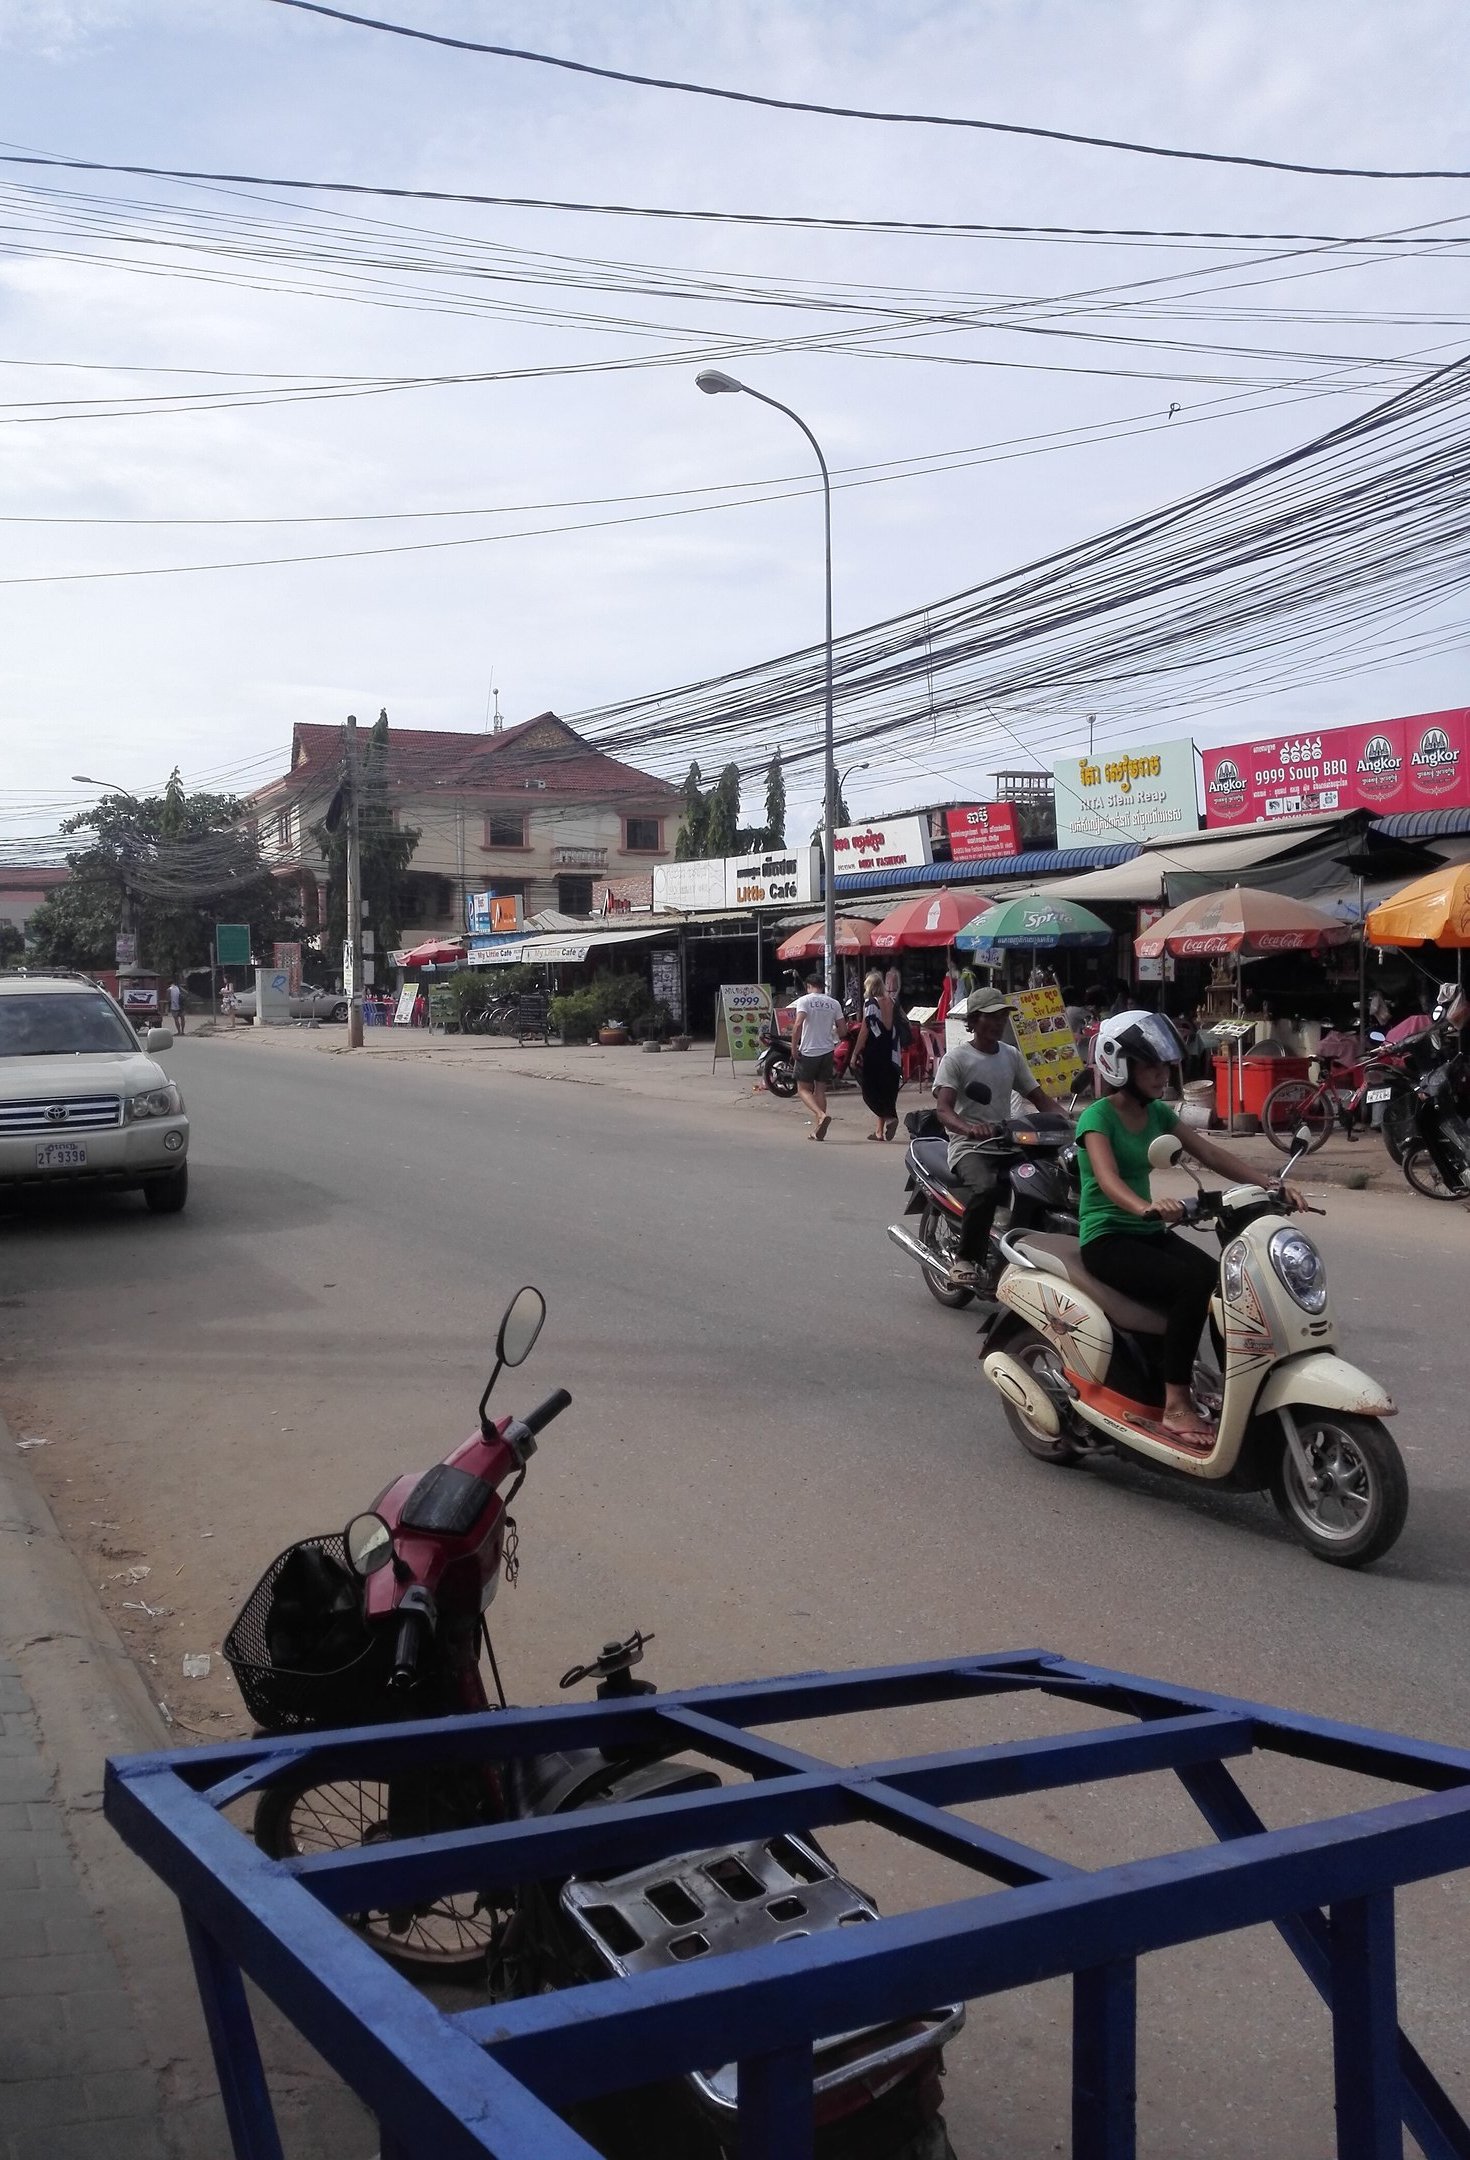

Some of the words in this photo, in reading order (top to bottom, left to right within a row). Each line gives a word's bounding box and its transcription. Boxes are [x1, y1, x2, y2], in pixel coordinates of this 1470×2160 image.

[1356, 757, 1402, 774] Angkor
[1411, 750, 1460, 767] Angkor
[1255, 768, 1285, 785] 9999
[1289, 765, 1319, 780] Soup
[1323, 759, 1348, 776] BBQ
[1208, 779, 1247, 794] Angkor
[1081, 797, 1104, 811] RITA
[1107, 793, 1134, 808] Siem
[1137, 790, 1167, 804] Reap
[876, 854, 908, 867] FASHION
[737, 885, 766, 903] Little
[769, 881, 797, 899] Café
[1025, 911, 1072, 928] Sprite
[1183, 937, 1227, 953] Coca-Cola
[1259, 932, 1303, 948] Coca-Cola
[733, 996, 760, 1006] 9999
[38, 1150, 86, 1165] 2T-9398
